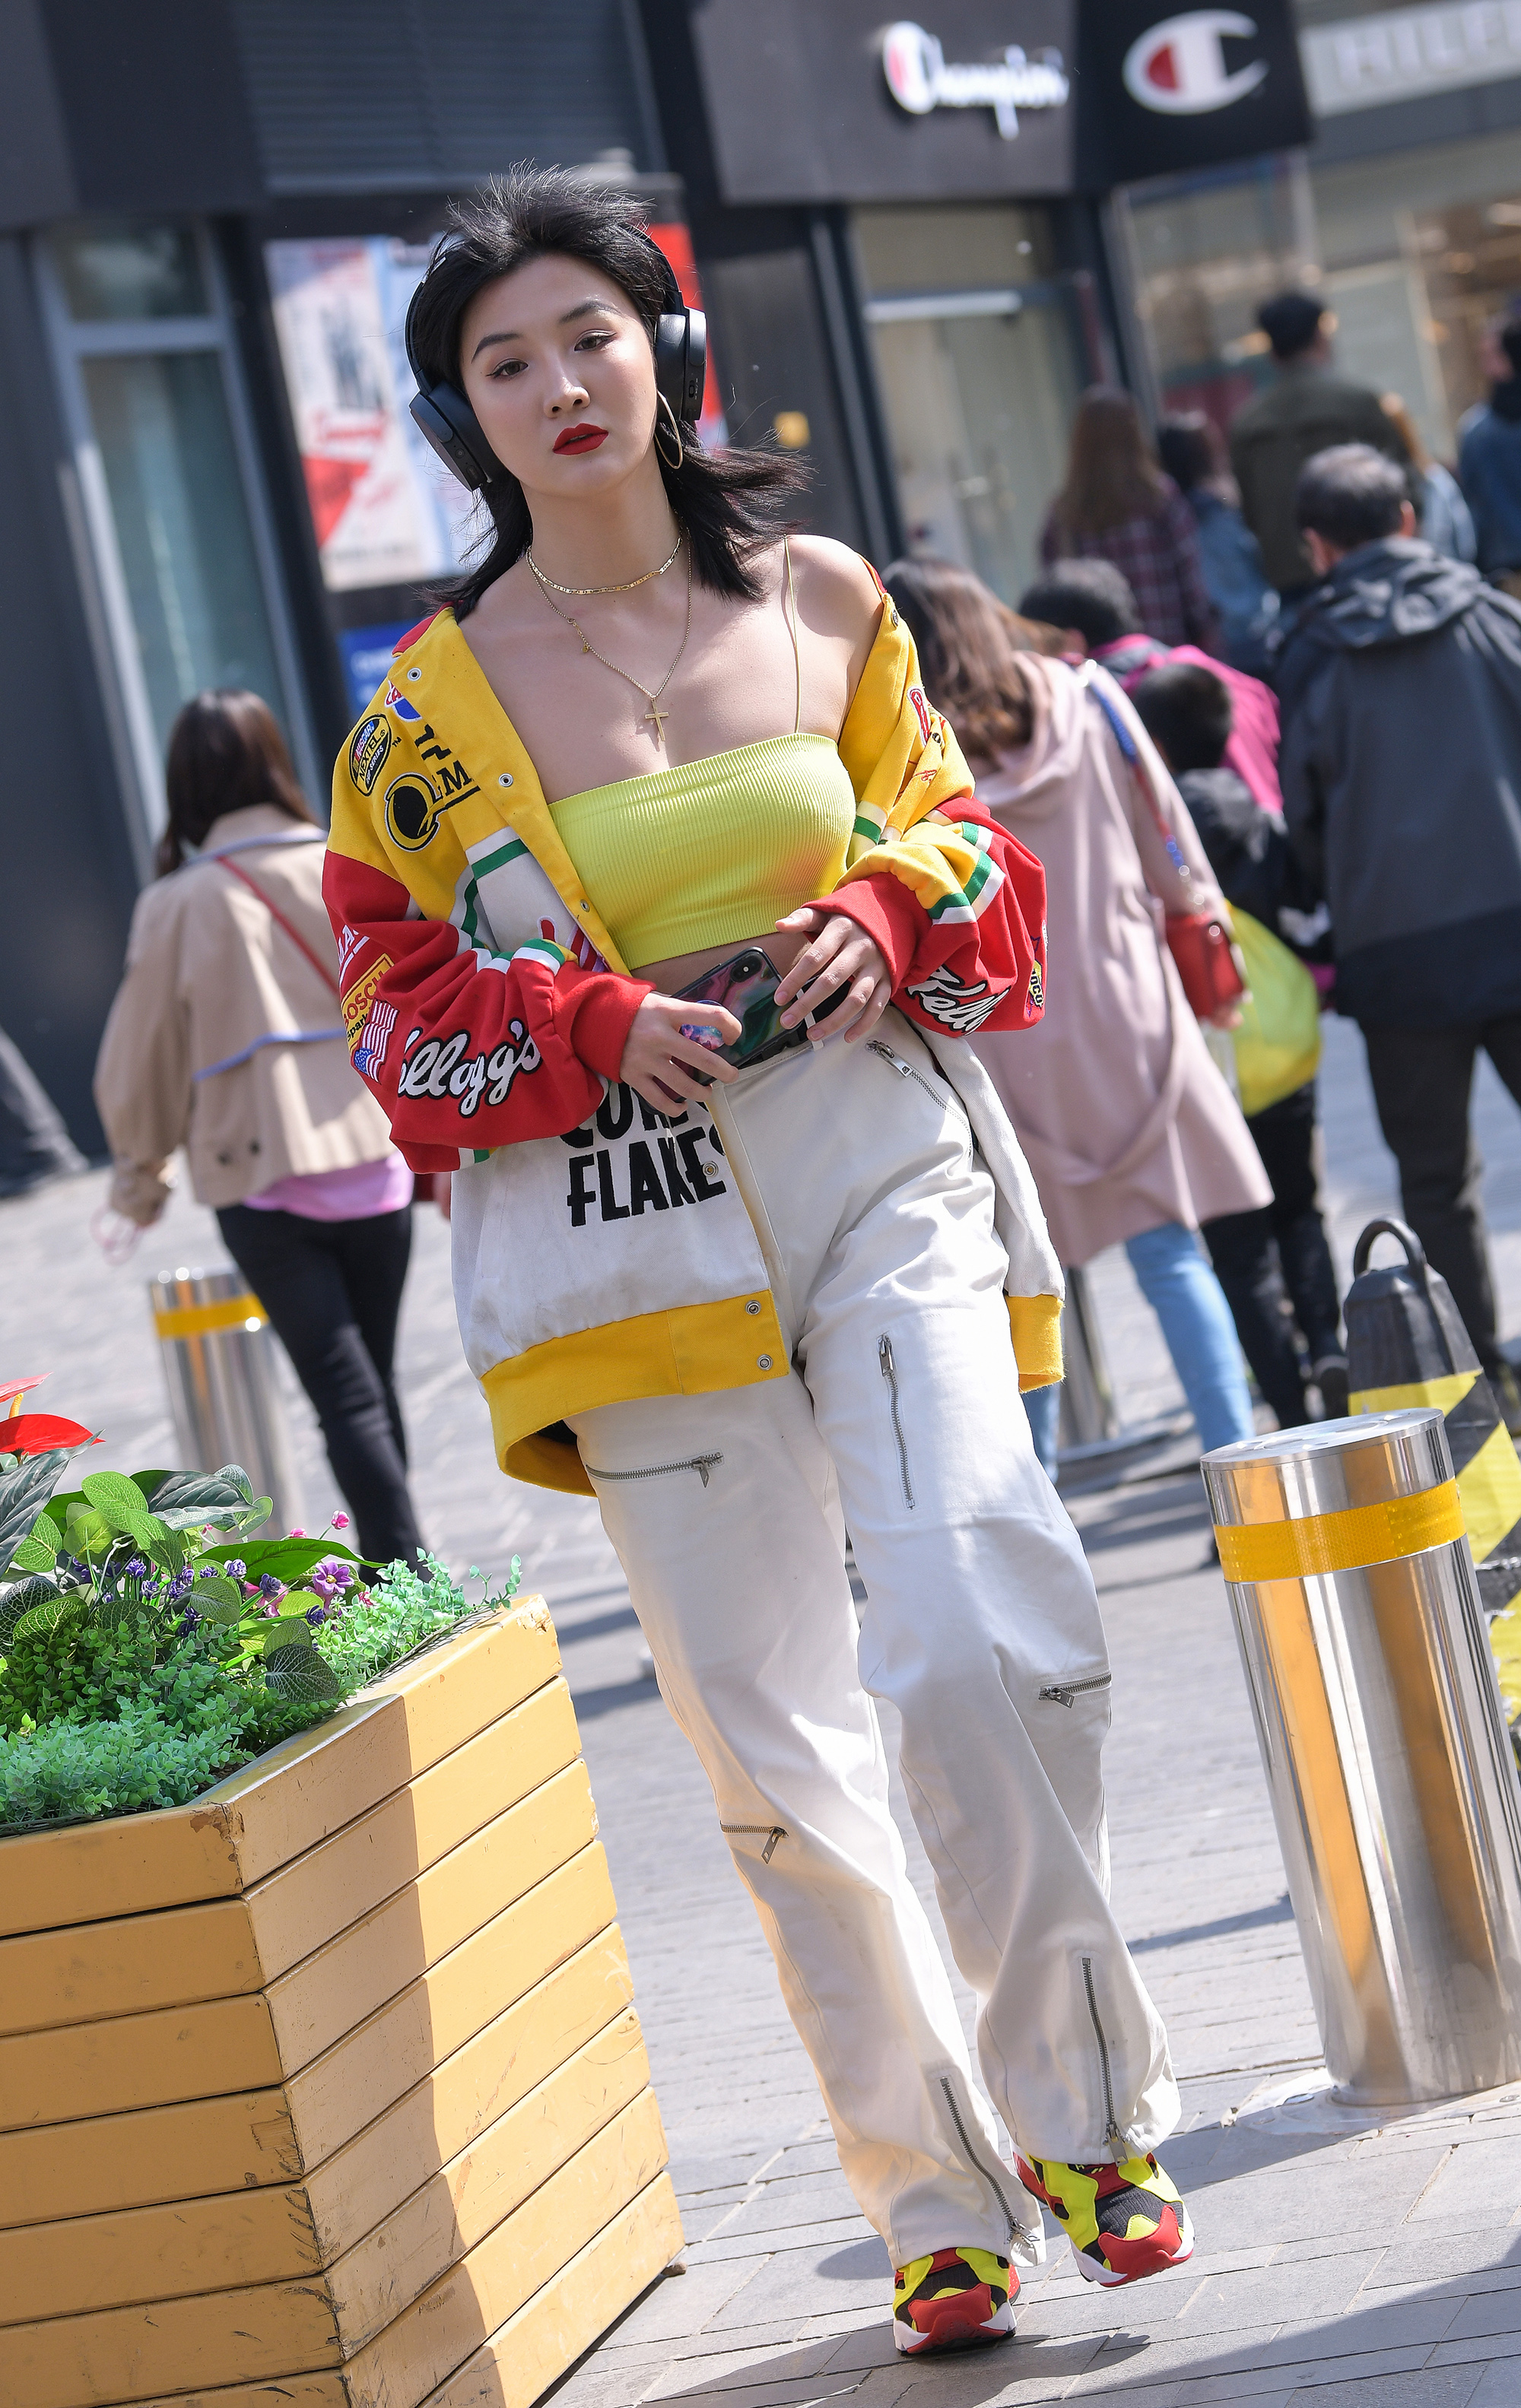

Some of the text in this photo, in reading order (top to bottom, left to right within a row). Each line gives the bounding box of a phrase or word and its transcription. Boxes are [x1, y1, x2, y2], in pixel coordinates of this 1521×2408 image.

[882, 21, 1070, 141] Champion
[359, 734, 382, 782] NEXTEL
[369, 744, 384, 771] SERIES
